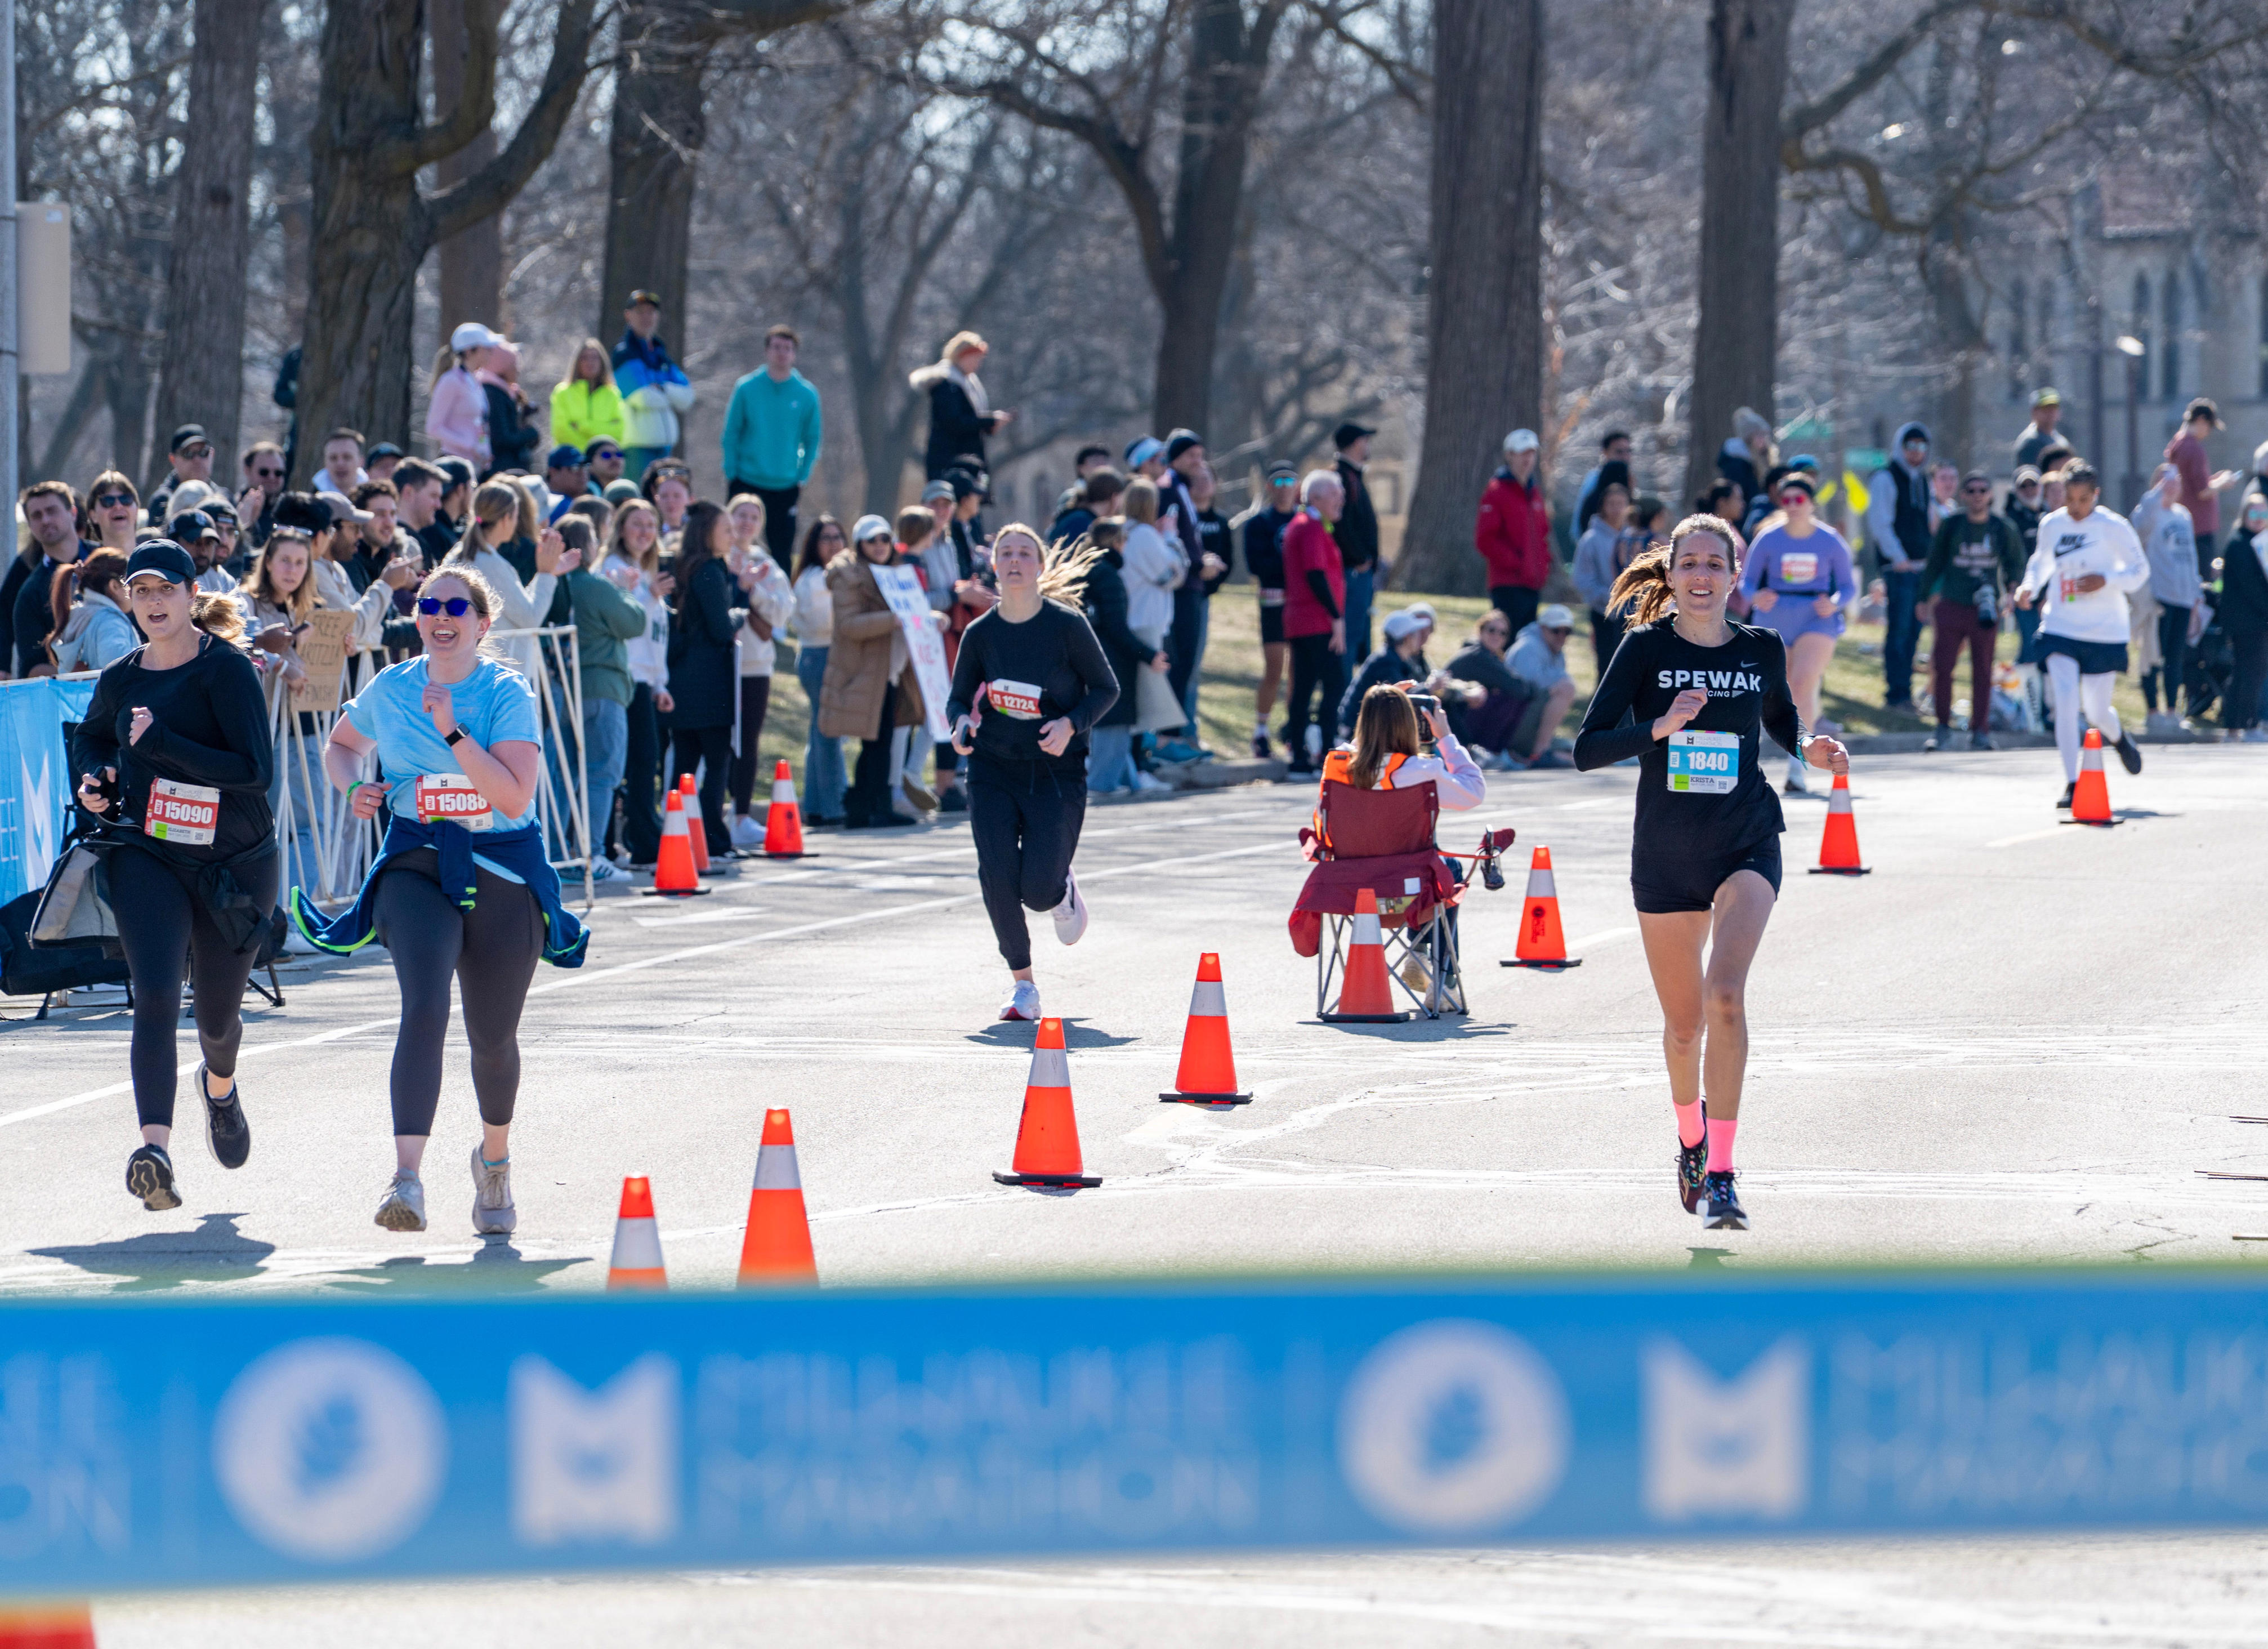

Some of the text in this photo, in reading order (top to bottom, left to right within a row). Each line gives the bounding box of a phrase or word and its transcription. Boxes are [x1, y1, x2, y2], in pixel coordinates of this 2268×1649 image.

[1658, 670, 1761, 692] SPEWAK
[1002, 696, 1035, 711] 12724
[1687, 752, 1729, 771] 1840
[164, 801, 213, 824] 15090
